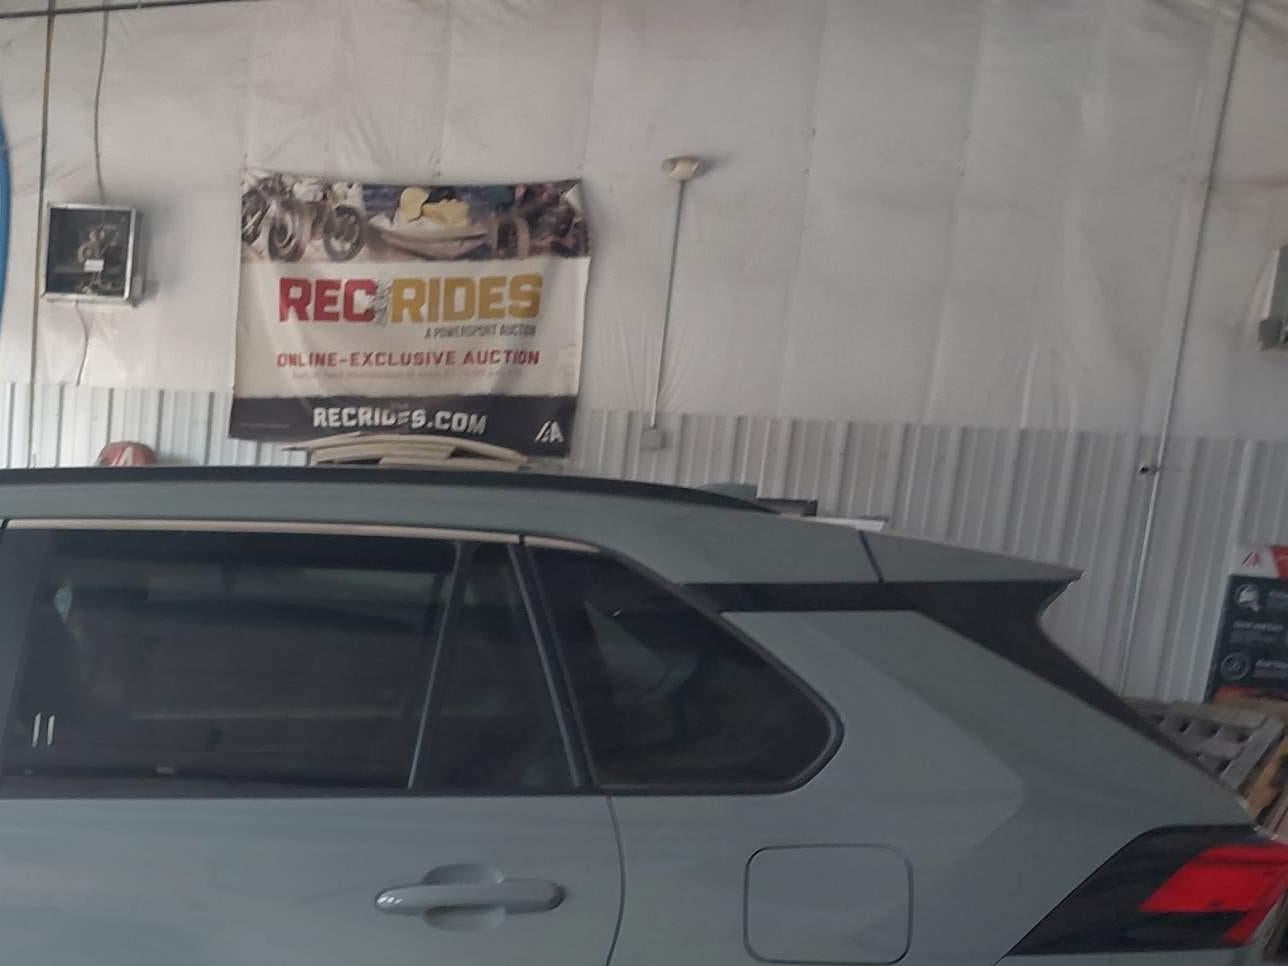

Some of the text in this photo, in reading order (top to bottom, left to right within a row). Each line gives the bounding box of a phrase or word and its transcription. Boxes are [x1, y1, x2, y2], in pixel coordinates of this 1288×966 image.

[278, 272, 544, 323] REC RIDES
[276, 349, 540, 368] ONLINE-EXCLUSIVE AUCTION
